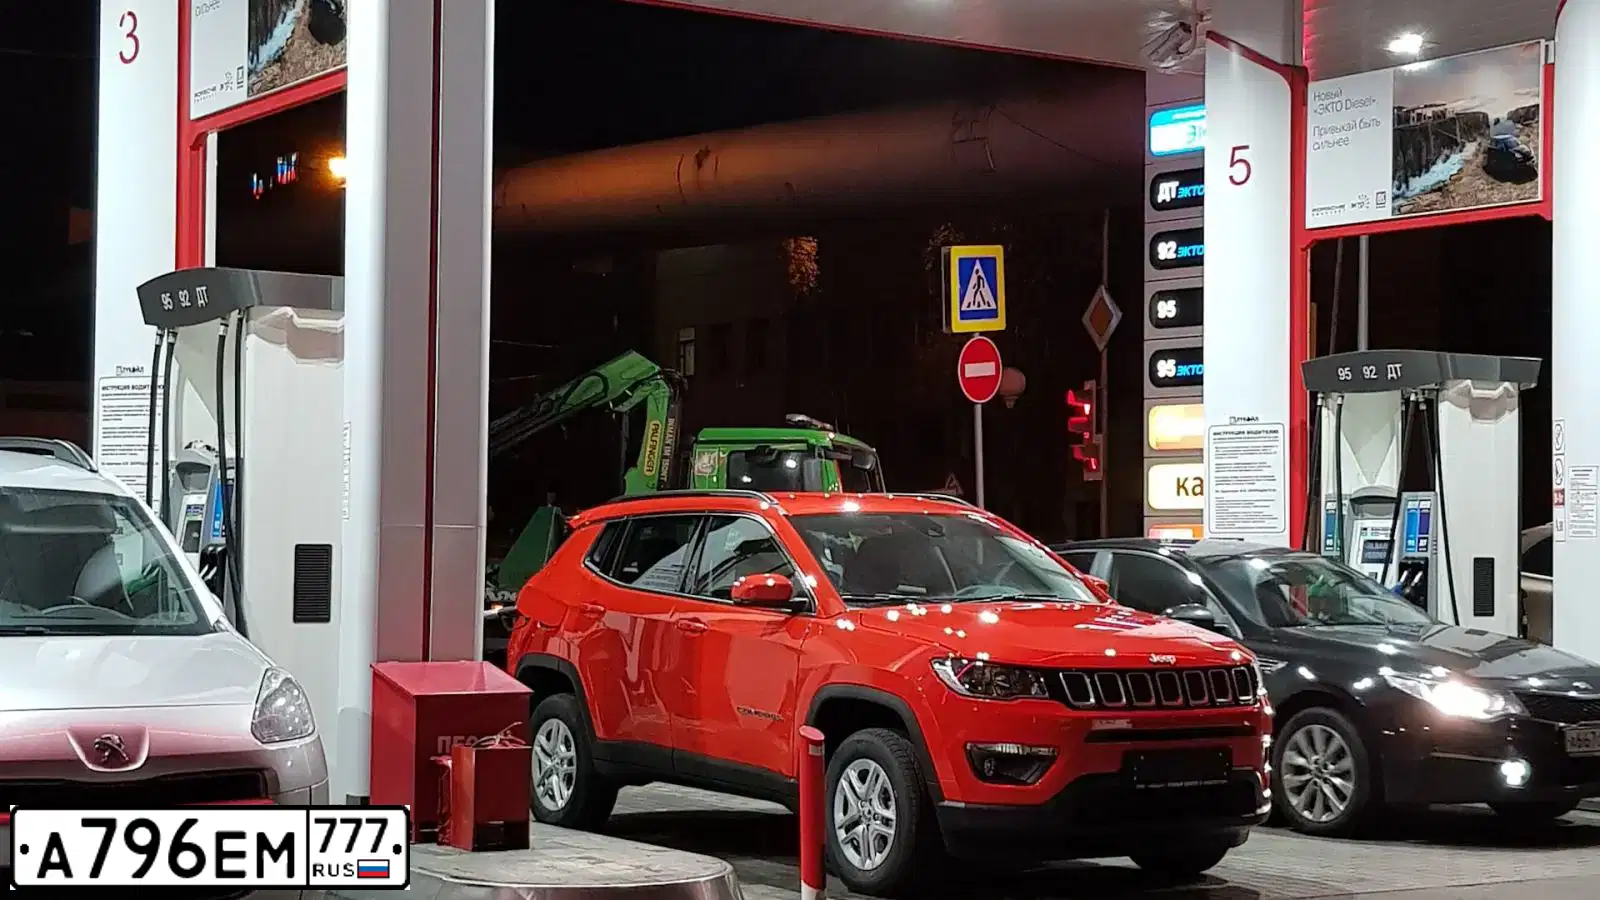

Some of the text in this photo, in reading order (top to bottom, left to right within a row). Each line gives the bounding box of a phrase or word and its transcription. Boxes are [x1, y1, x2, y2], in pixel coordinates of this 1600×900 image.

[119, 10, 140, 64] 3
[1313, 88, 1343, 102] Новый
[1313, 120, 1357, 137] Привыкай
[1229, 144, 1251, 186] 5
[1157, 181, 1180, 203] ДТ
[1157, 240, 1177, 260] 92
[161, 292, 174, 310] 95
[178, 289, 192, 308] 92
[1156, 300, 1177, 319] 95
[1156, 359, 1177, 378] 95
[1337, 363, 1403, 381] 95 92 ДТ
[1149, 653, 1176, 665] Jeep
